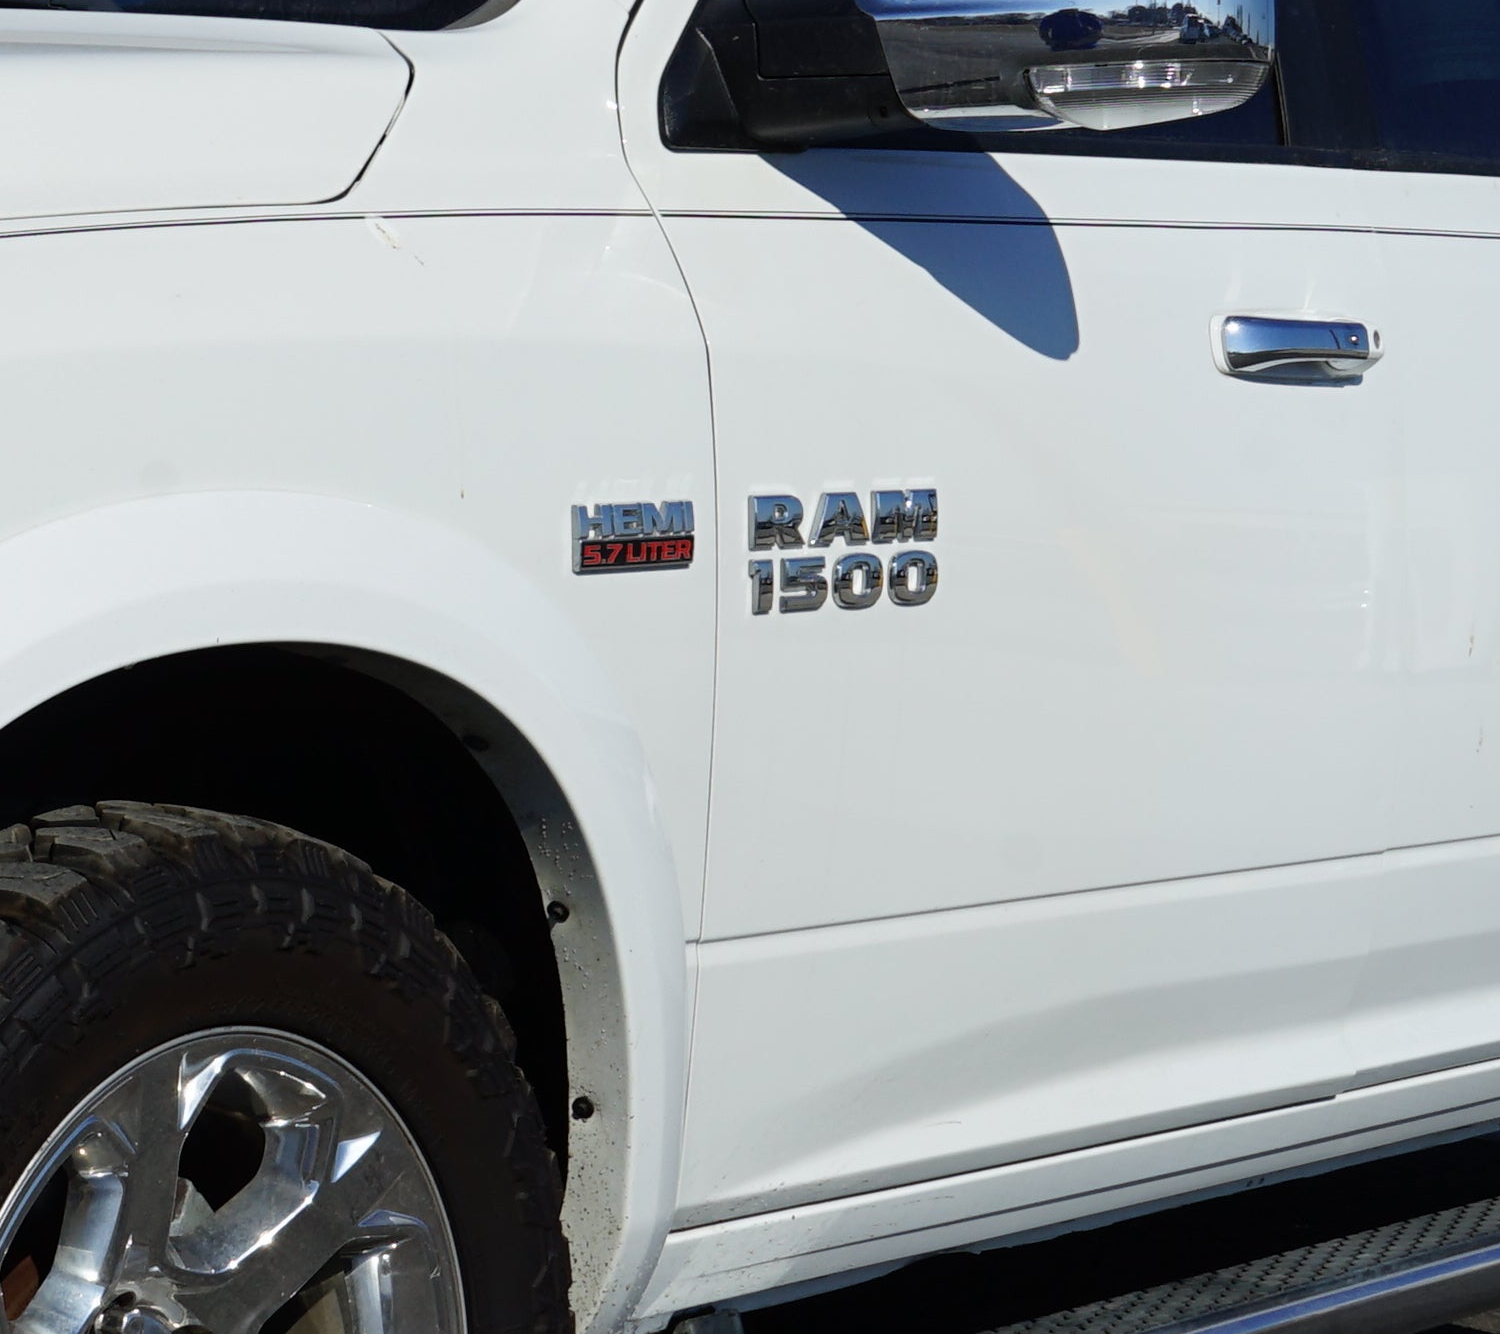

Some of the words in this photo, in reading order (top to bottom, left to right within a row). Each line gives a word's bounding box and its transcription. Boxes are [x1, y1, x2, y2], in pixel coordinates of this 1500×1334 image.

[571, 500, 694, 539] HEMI
[747, 488, 939, 551] RAM
[583, 543, 623, 566] 5.7
[625, 539, 692, 563] LITER
[747, 550, 939, 616] 1500
